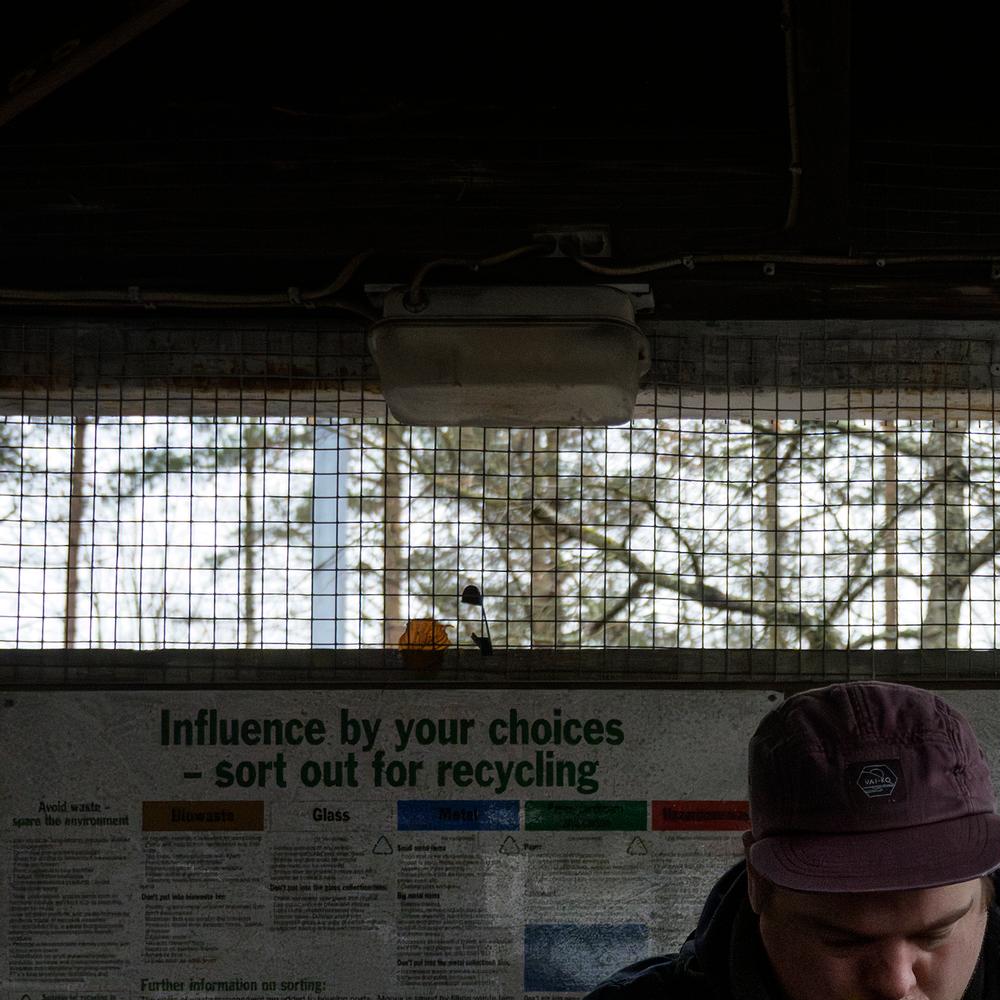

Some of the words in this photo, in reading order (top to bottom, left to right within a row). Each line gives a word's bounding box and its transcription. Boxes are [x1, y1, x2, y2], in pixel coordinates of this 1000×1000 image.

[160, 709, 326, 746] Influence
[340, 709, 381, 752] by
[395, 718, 475, 752] your
[488, 709, 625, 746] choices
[215, 753, 287, 788] sort
[301, 753, 359, 788] out
[371, 751, 424, 788] for
[437, 751, 600, 795] recycling
[312, 808, 351, 822] Glass
[141, 979, 184, 992] Further
[190, 979, 257, 992] information
[262, 979, 276, 992] on
[281, 979, 326, 993] sorting:
